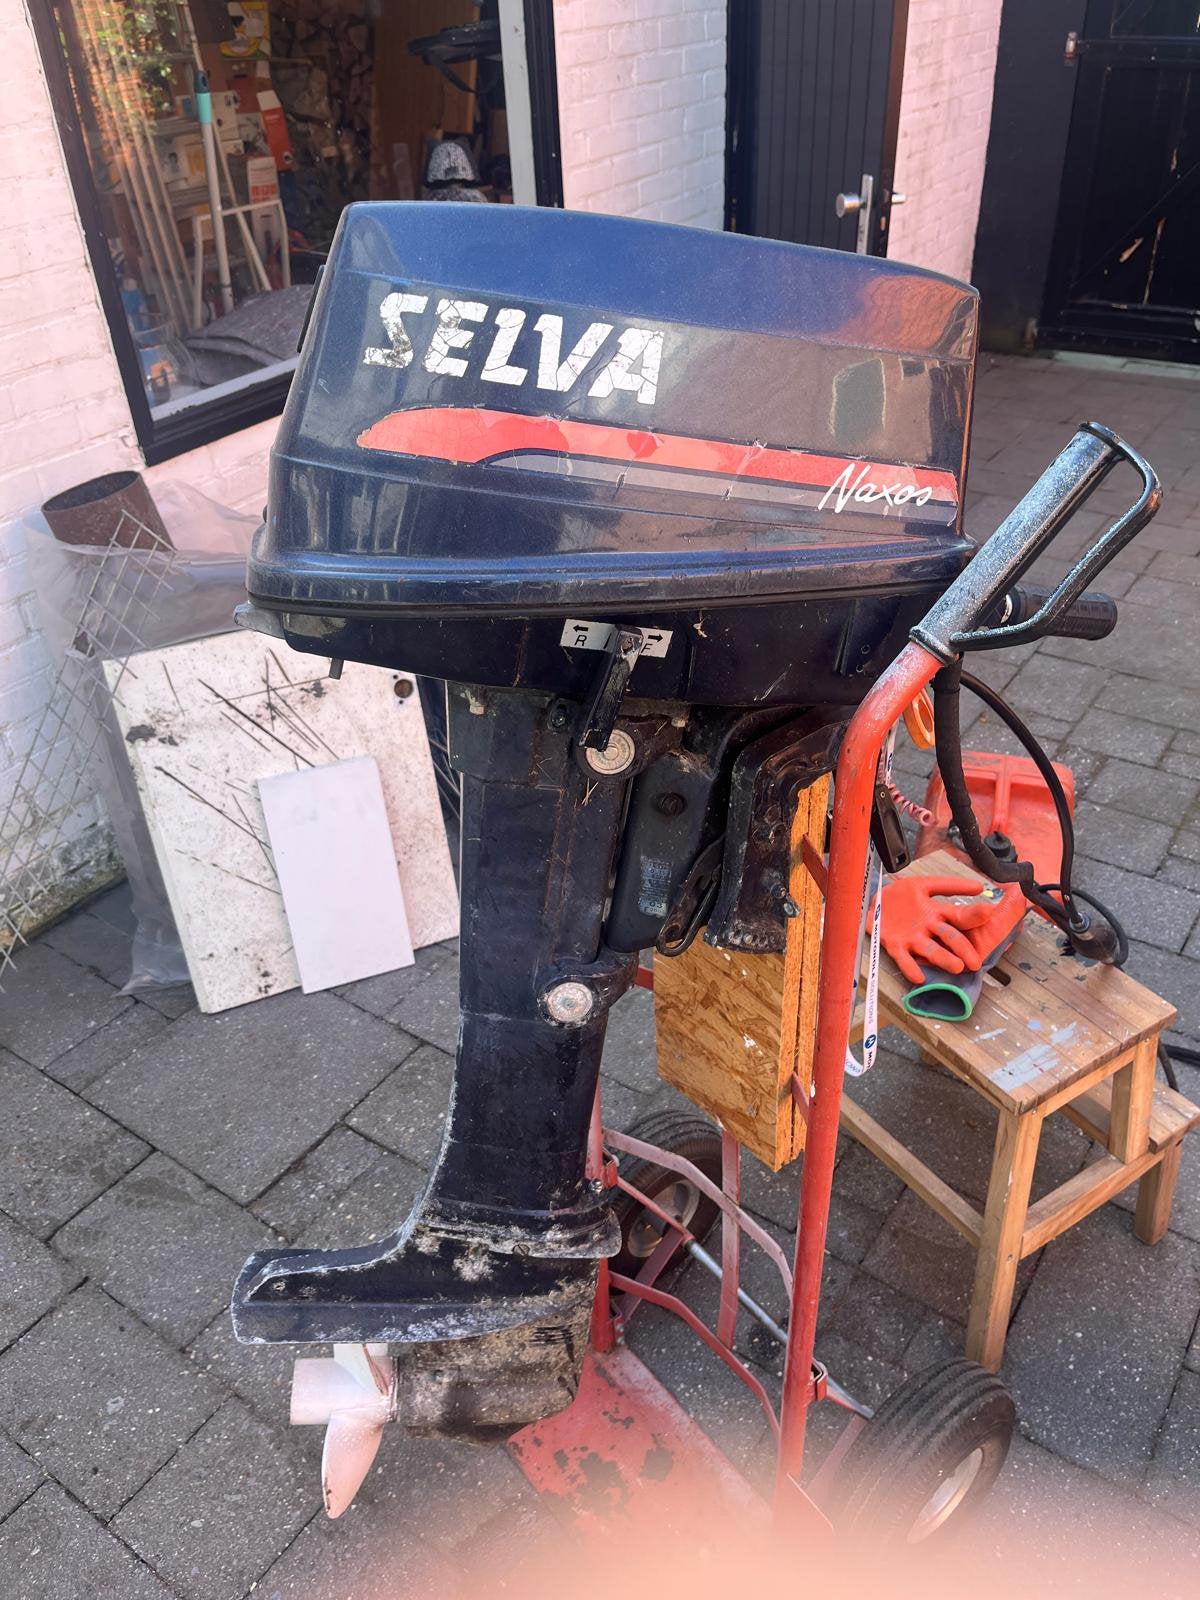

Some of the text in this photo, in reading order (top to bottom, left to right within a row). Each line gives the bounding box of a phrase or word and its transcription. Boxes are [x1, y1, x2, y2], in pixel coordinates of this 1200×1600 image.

[362, 292, 664, 405] SELVA
[817, 462, 933, 514] Naxos
[574, 634, 588, 647] R
[641, 643, 653, 653] F
